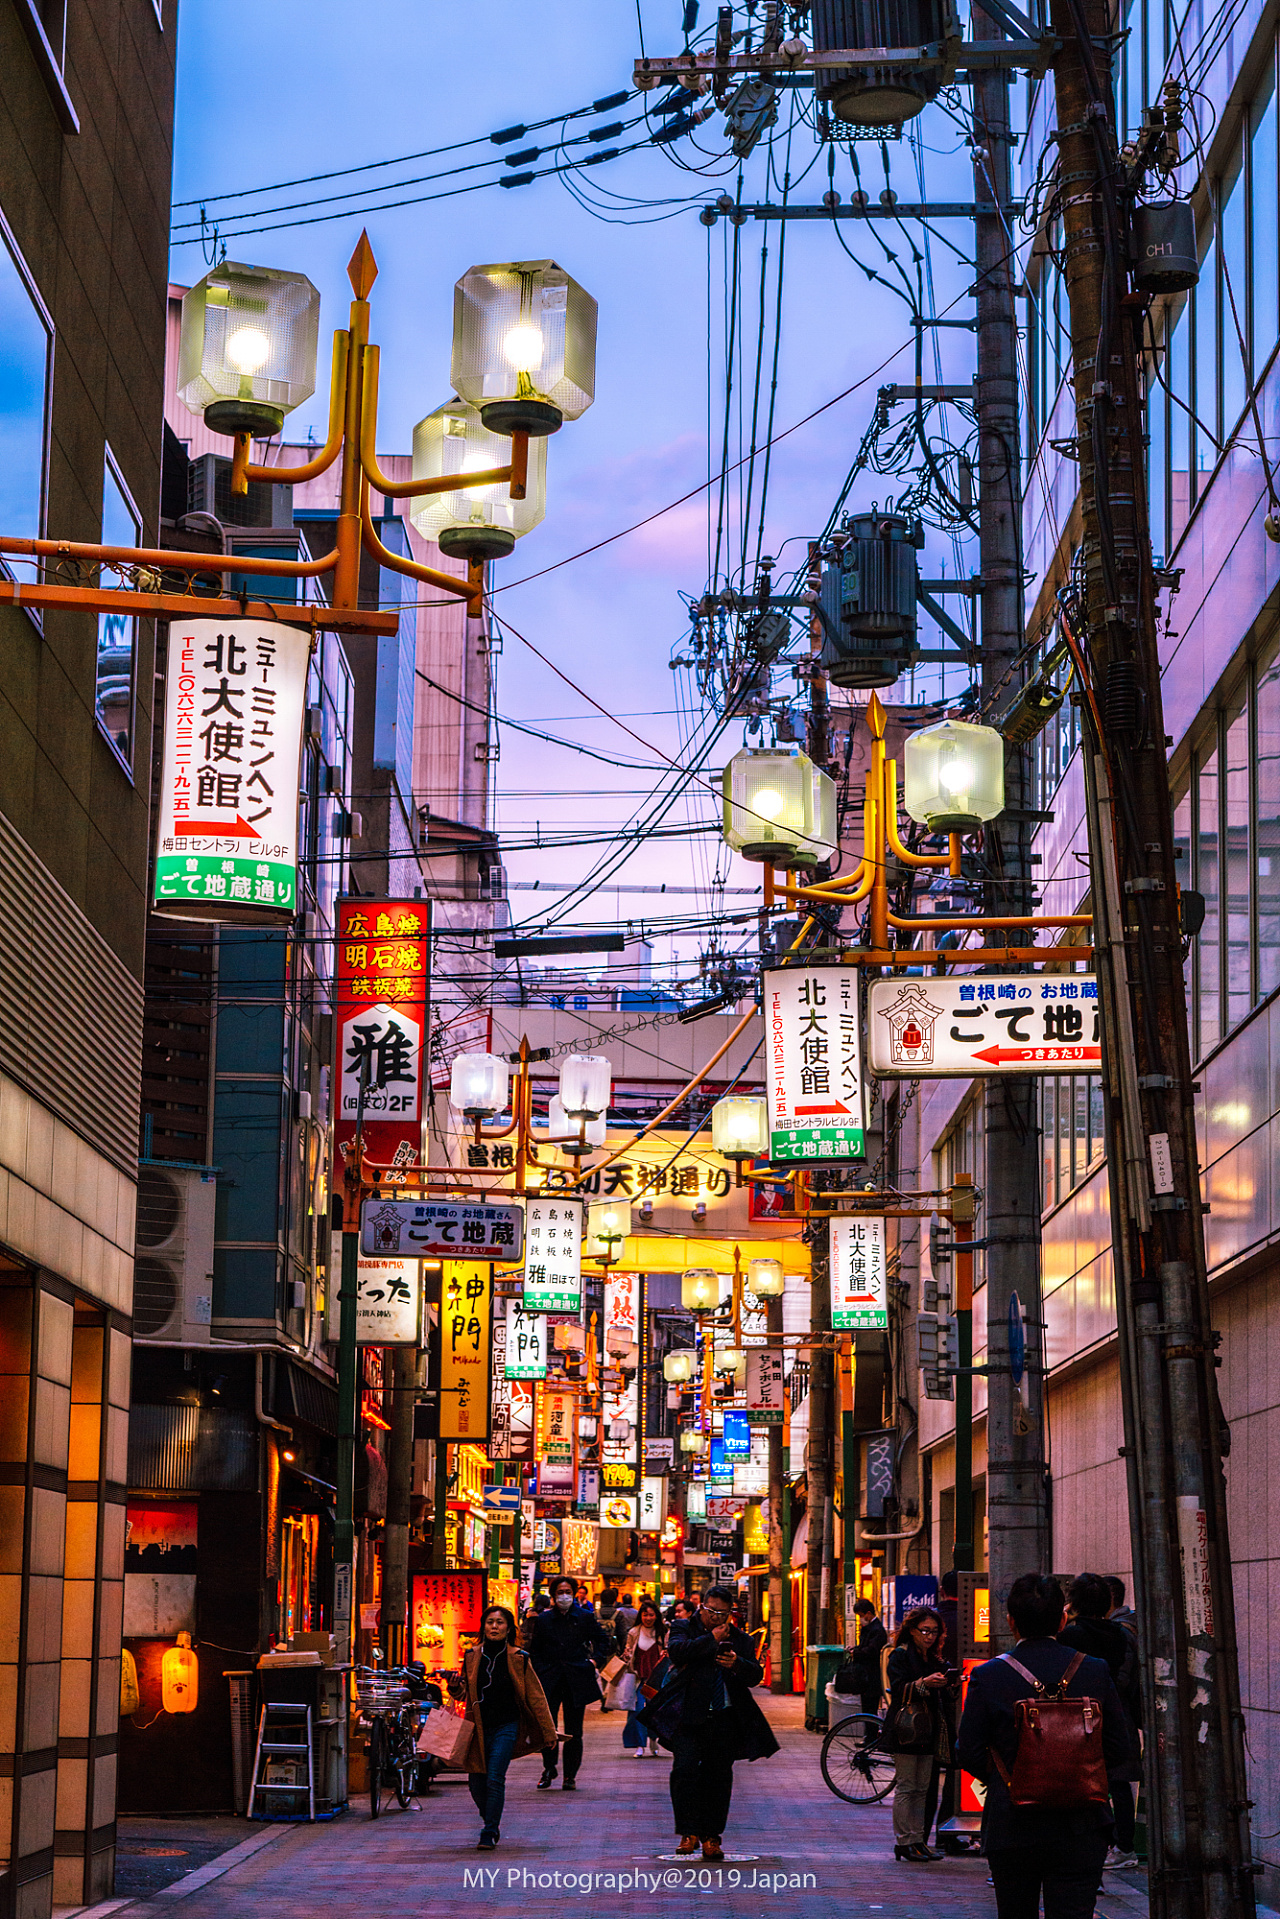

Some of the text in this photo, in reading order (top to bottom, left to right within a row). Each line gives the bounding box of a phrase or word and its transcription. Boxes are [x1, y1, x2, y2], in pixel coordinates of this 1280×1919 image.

[1146, 242, 1172, 257] CH1
[197, 633, 247, 809] 北大使館
[246, 636, 277, 823] ニューミュンヘン
[159, 873, 292, 904] ごて地蔵通り
[345, 912, 423, 940] 広島焼
[345, 944, 423, 970] 明石焼
[351, 975, 415, 997] 鉄板焼
[959, 984, 1032, 1001] 曽根崎の
[798, 978, 830, 1095] 北大使館
[839, 978, 859, 1101] ニューミュンヘン
[345, 1019, 417, 1089] 雅
[1021, 1047, 1085, 1060] つきあたり
[775, 1140, 861, 1158] ごて地蔵通り
[1155, 1140, 1167, 1187] 215-240-0
[415, 1207, 512, 1221] 曽根崎の お地蔵さん
[408, 1217, 515, 1245] ごて地蔵
[449, 1246, 487, 1255] つきあたり
[849, 1223, 866, 1291] 北大使館
[447, 1273, 485, 1352] 神門
[525, 1298, 578, 1310] ごて地蔵通り
[452, 1355, 482, 1365] Mikado
[902, 1592, 935, 1606] Asahi
